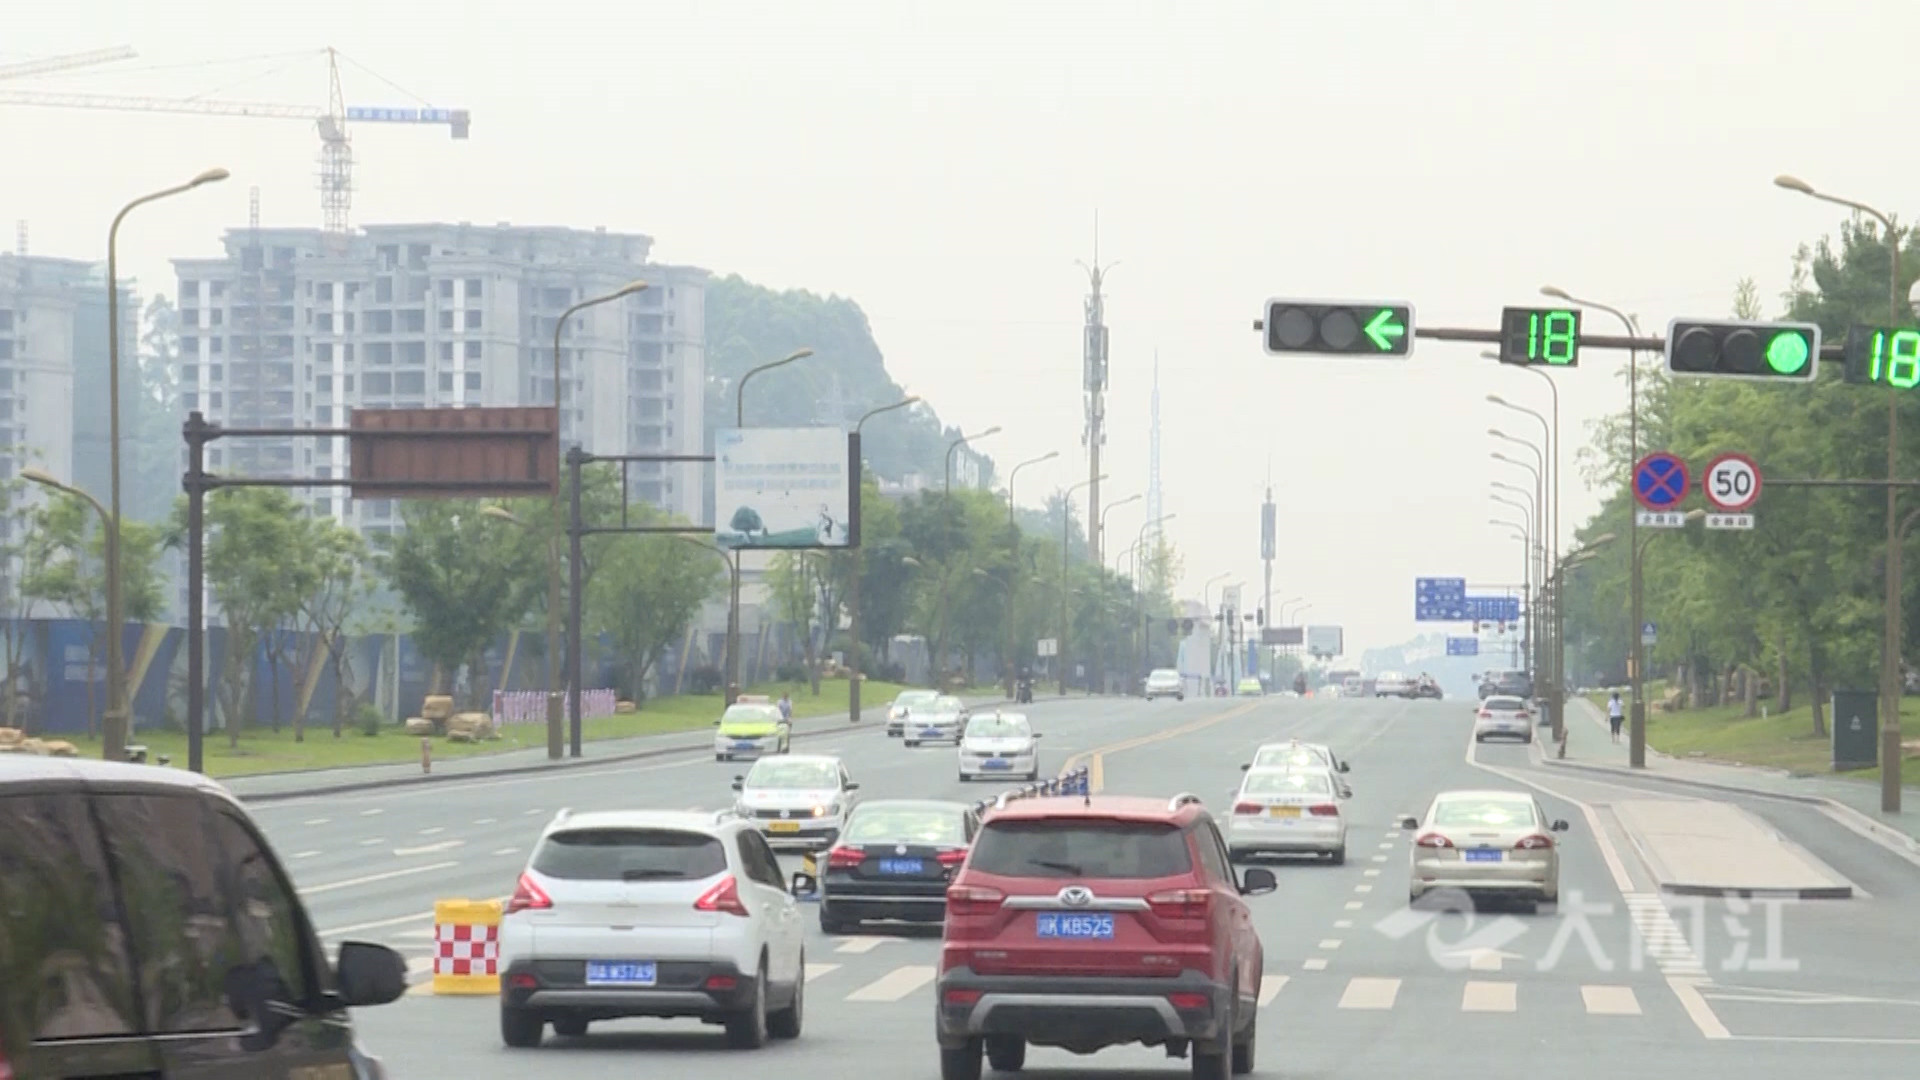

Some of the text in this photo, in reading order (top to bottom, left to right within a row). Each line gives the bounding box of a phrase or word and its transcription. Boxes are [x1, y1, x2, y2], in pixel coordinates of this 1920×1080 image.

[1528, 309, 1576, 366] 18
[1870, 330, 1920, 388] 18
[1716, 469, 1751, 496] 50
